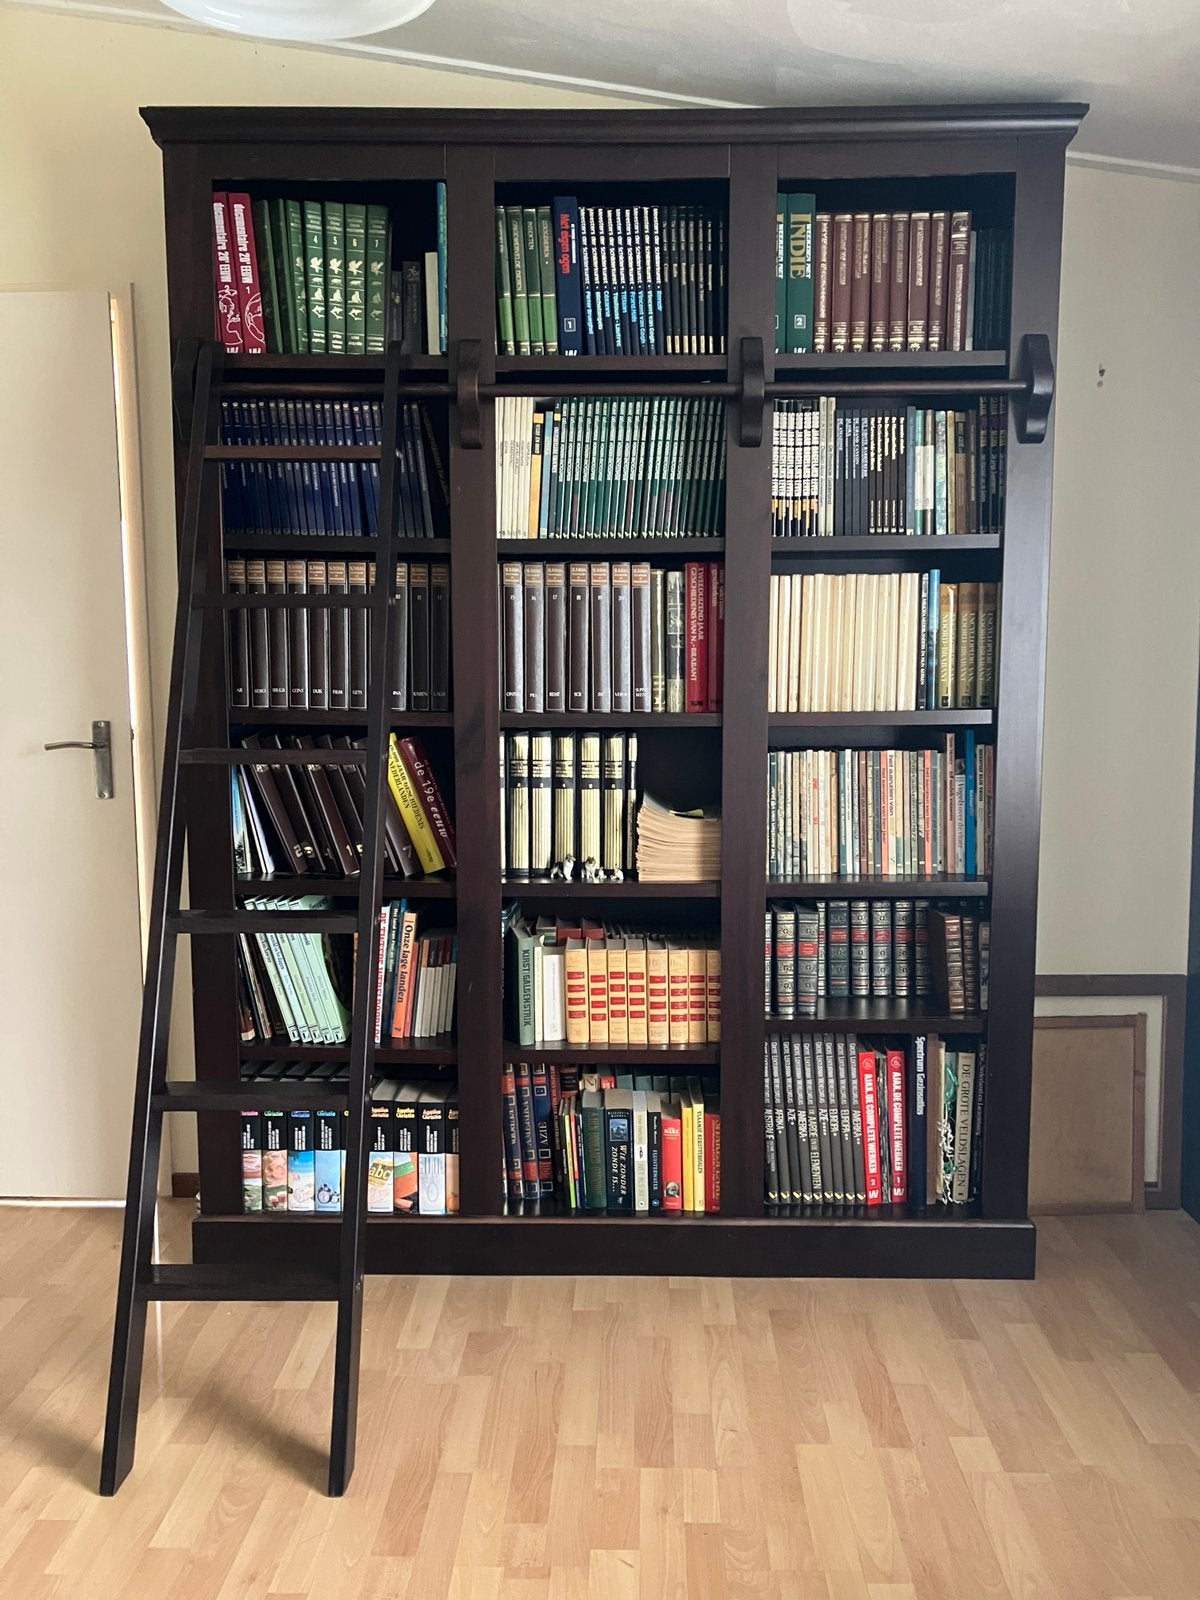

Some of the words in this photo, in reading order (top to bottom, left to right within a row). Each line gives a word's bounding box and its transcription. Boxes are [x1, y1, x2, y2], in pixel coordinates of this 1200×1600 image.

[558, 231, 570, 252] eigen
[559, 254, 571, 274] ogen
[414, 761, 425, 777] de
[421, 780, 435, 802] 19e
[430, 805, 448, 838] eeuw
[956, 783, 965, 807] Vogels
[404, 924, 413, 950] Onze
[401, 952, 411, 972] lage
[522, 949, 531, 973] KIRST
[397, 973, 408, 1004] landen
[523, 973, 532, 1027] GALGENSTRIK
[916, 1036, 926, 1072] Spectrum
[961, 1064, 971, 1079] DE
[960, 1082, 970, 1115] GROTE
[866, 1103, 876, 1143] COMPLETE
[893, 1101, 903, 1140] COMPLETE
[619, 1145, 627, 1161] WIE
[868, 1142, 877, 1174] WERKEN
[893, 1140, 903, 1171] WERKEN
[957, 1119, 968, 1187] VELDSLAGEN
[369, 1164, 391, 1180] abc
